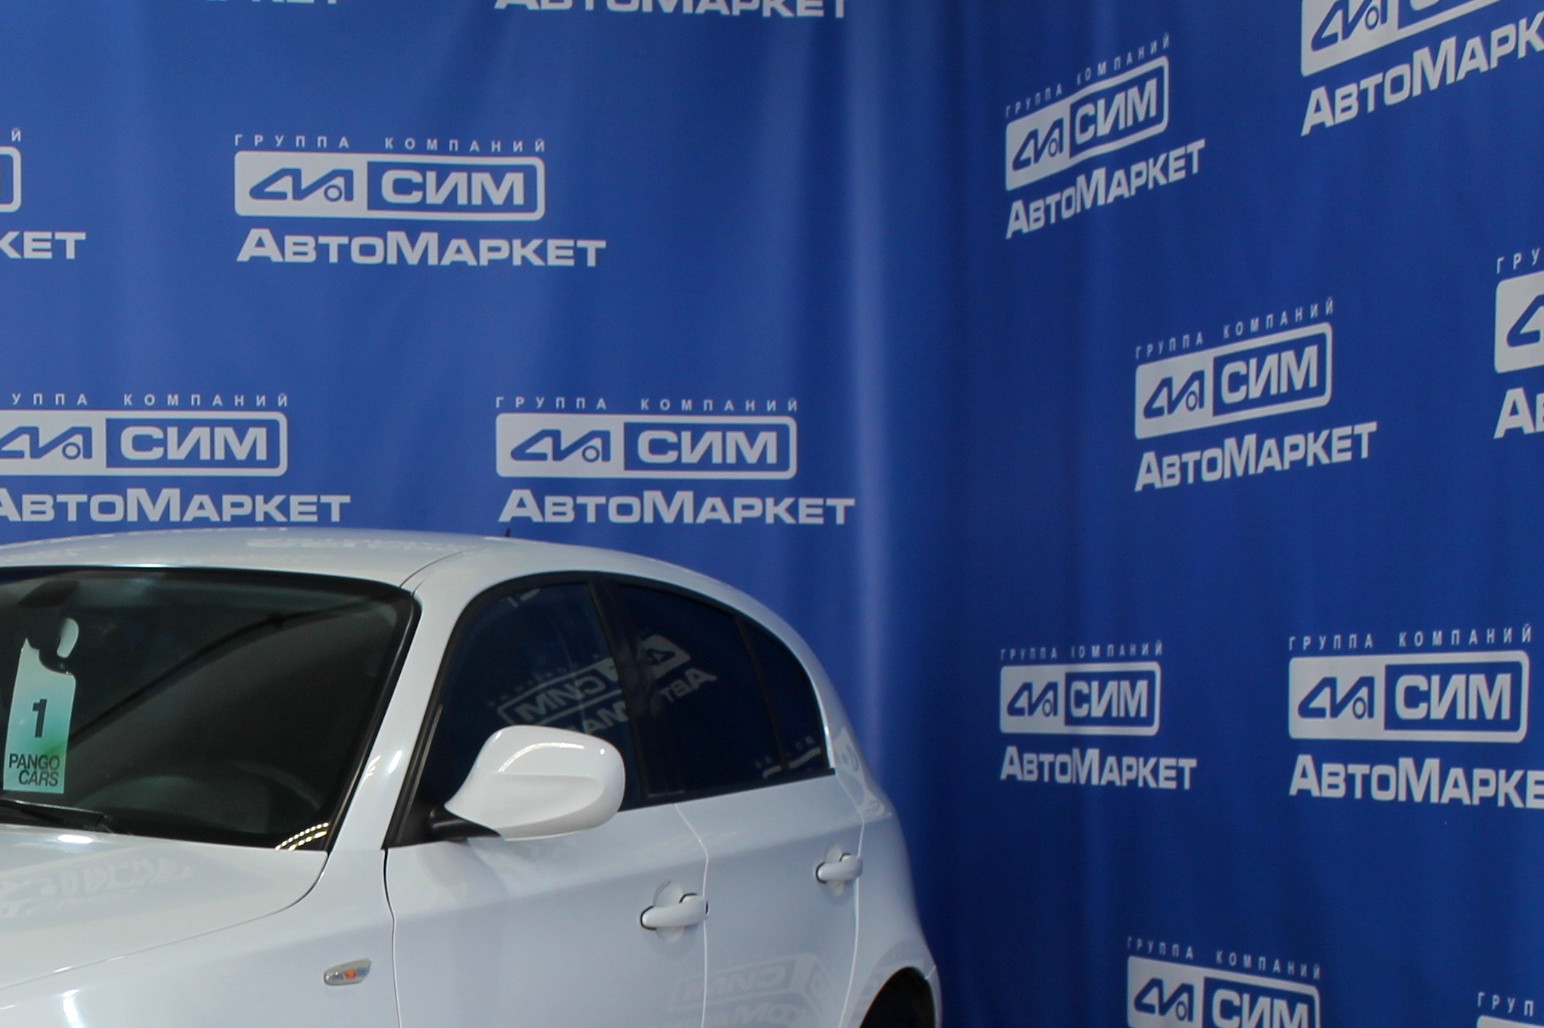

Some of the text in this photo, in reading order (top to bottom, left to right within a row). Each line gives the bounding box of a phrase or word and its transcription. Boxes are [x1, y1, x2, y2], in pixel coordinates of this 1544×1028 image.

[1075, 78, 1157, 145] СИМ
[235, 134, 545, 152] ГРУППА КОМПАНИЙ
[382, 169, 524, 207] СИМ
[1135, 297, 1334, 360] ГРУППА КОМПАНИЙ
[1221, 344, 1319, 404] СИМ
[124, 394, 287, 406] КОМПАНИЙ
[496, 396, 797, 411] ГРУППА КОМПАНИЙ
[121, 426, 267, 460] СИМ
[638, 430, 777, 463] СИМ
[1289, 623, 1532, 651] ГРУППА КОМПАНИЙ
[1070, 679, 1149, 719] СИМ
[1395, 673, 1512, 721] СИМ
[32, 698, 48, 738] 1
[9, 753, 61, 771] PANGO
[18, 769, 59, 787] CARS
